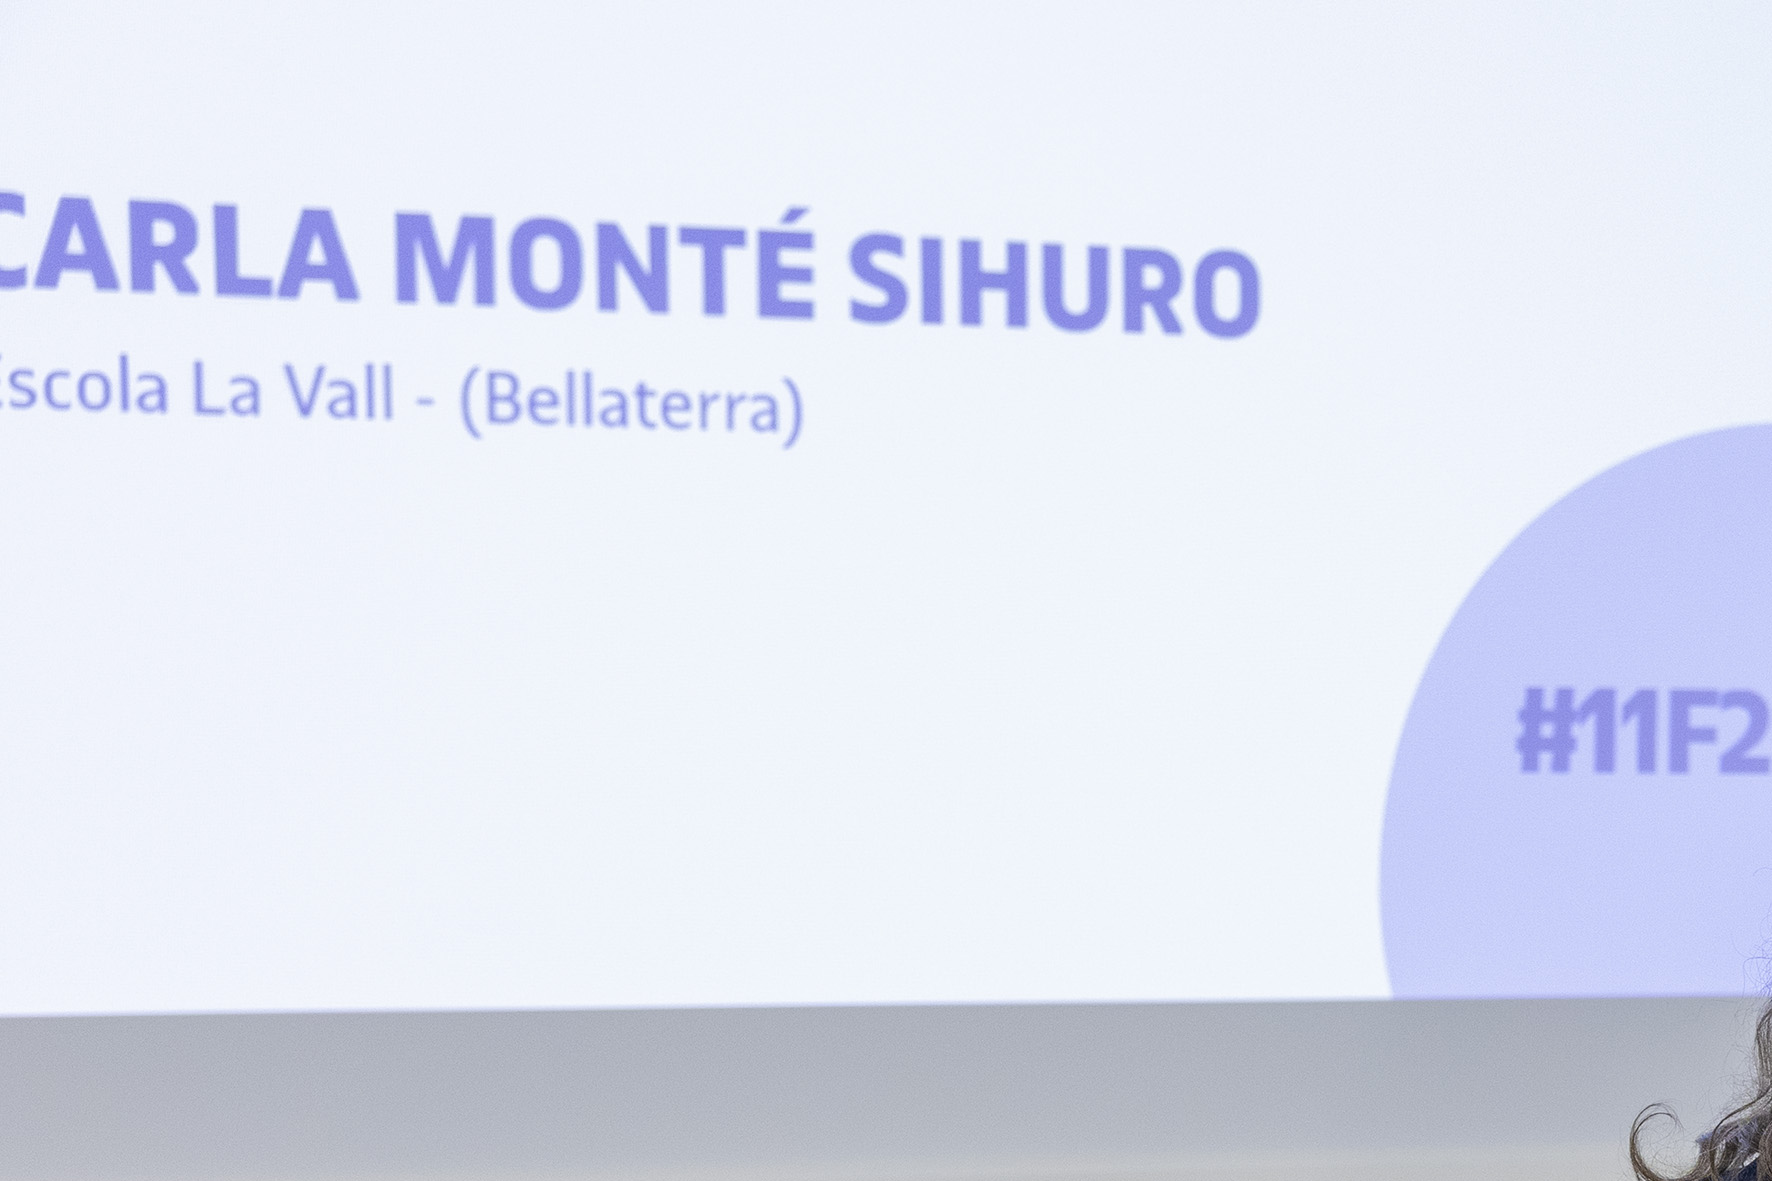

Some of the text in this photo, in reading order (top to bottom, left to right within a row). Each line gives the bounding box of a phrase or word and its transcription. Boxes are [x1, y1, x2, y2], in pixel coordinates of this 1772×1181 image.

[393, 206, 816, 321] MONTÉ
[847, 231, 1262, 340] SIHURO
[0, 352, 169, 415] scola
[191, 359, 262, 418] La
[282, 362, 395, 421] Vall
[460, 366, 804, 449] (Bellaterra)
